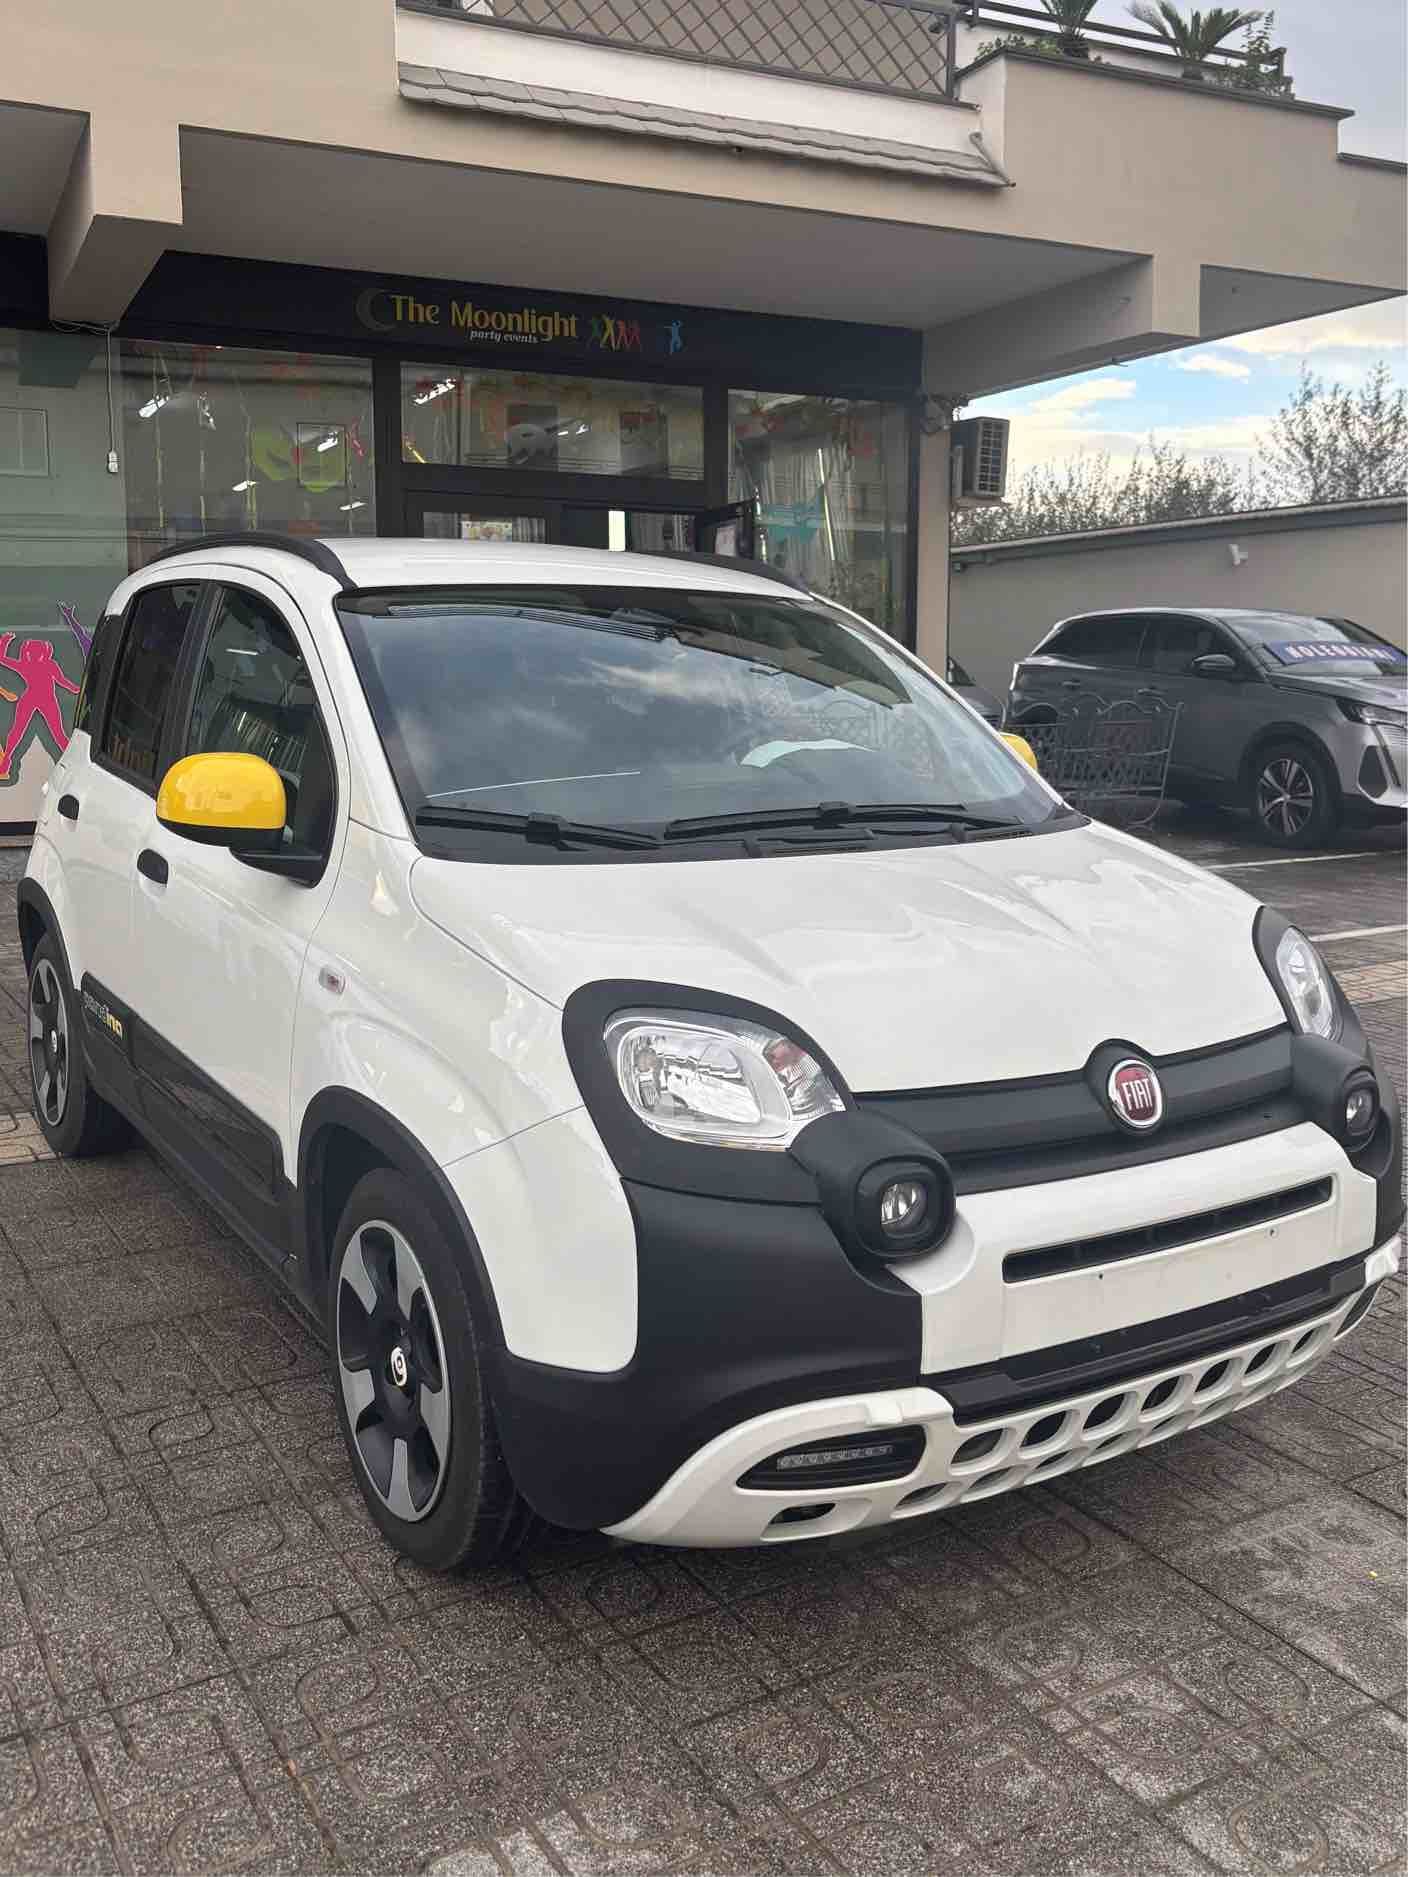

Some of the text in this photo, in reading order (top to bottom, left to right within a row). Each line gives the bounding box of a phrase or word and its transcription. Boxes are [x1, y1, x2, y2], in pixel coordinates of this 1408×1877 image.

[390, 295, 578, 341] The Moonlight
[470, 329, 539, 344] party events
[1121, 1078, 1153, 1110] FIAT
